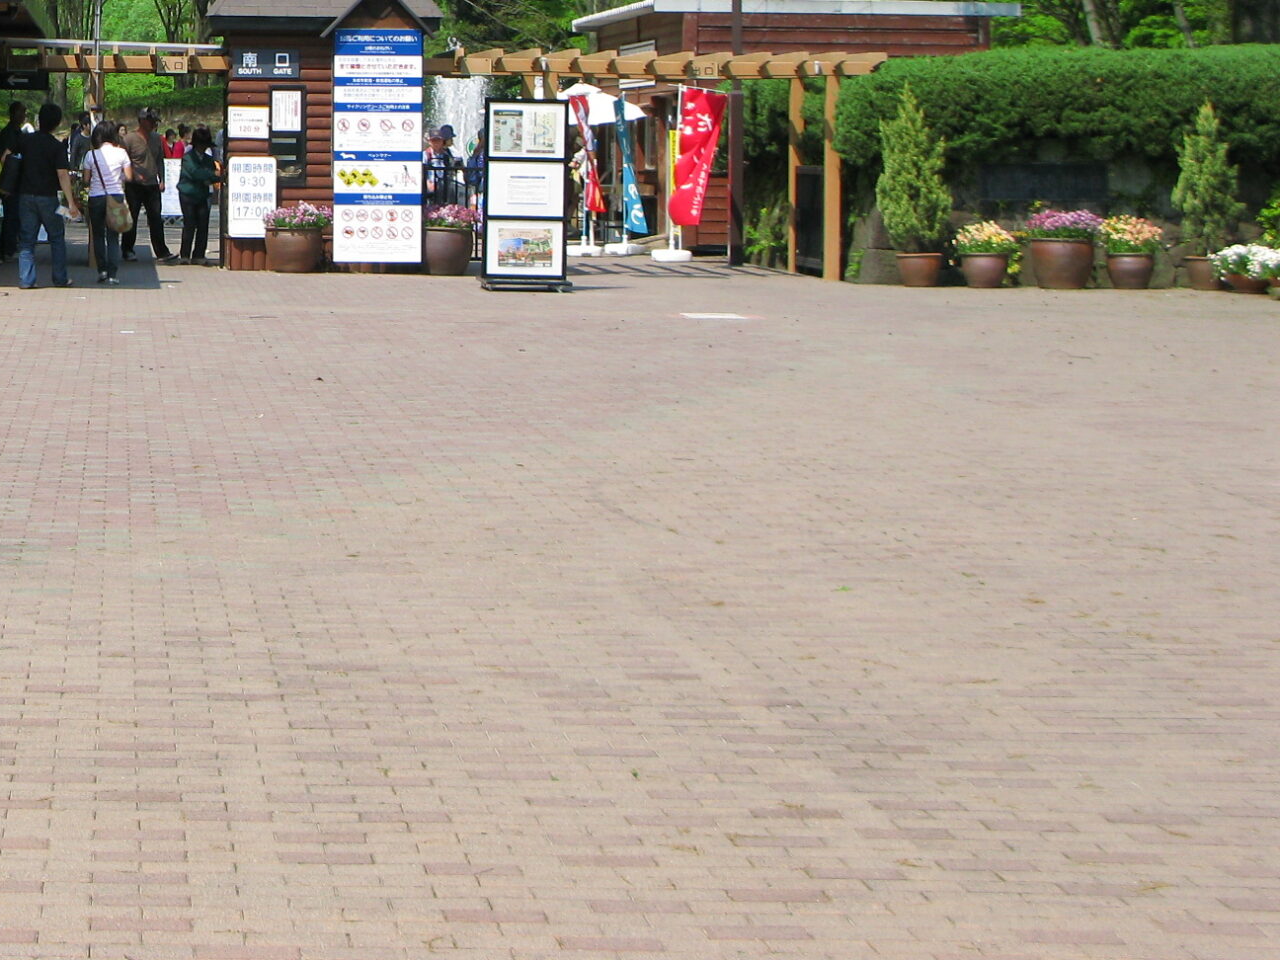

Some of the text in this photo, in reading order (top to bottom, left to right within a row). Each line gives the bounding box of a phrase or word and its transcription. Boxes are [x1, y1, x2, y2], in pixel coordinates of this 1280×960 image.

[161, 60, 183, 70] 入口
[231, 163, 273, 173] 開園時間
[239, 176, 266, 187] 9:30
[231, 192, 273, 203] 閉園時間
[236, 206, 269, 217] 17:00
